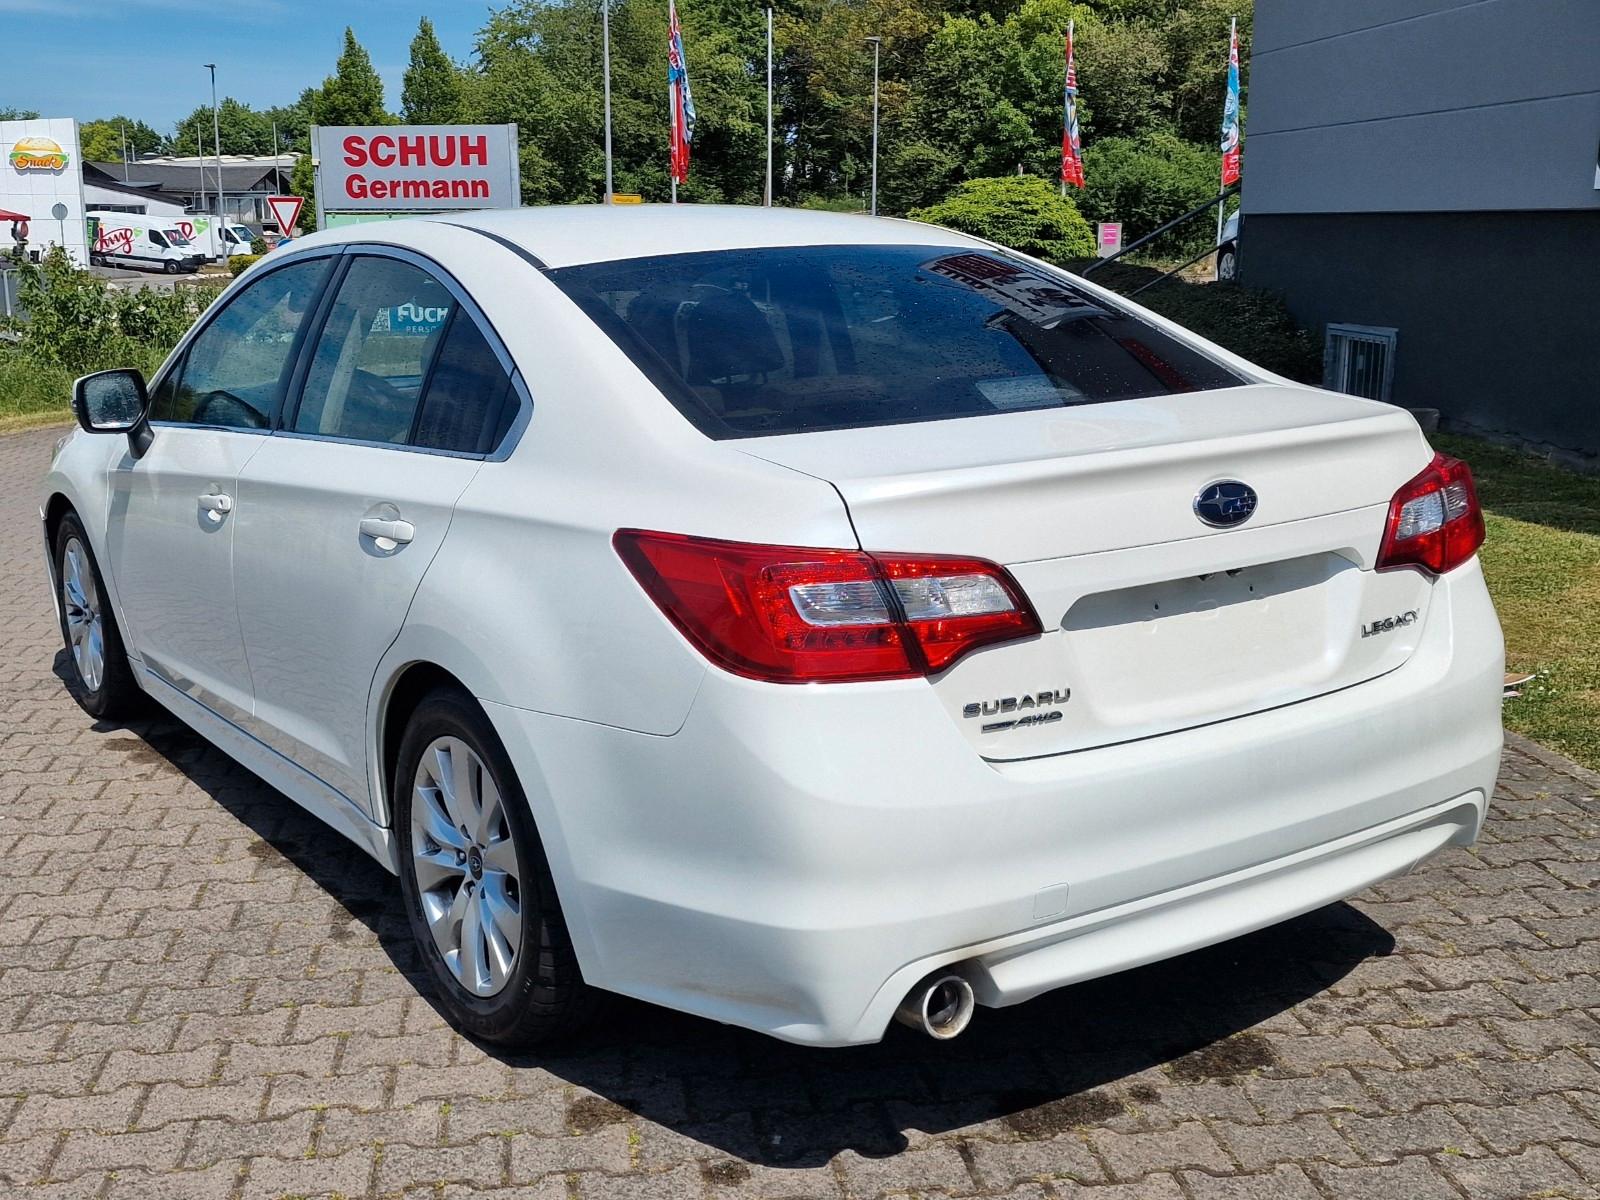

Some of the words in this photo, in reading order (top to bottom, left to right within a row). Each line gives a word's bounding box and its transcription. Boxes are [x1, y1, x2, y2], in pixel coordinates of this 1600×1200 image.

[15, 154, 64, 169] Snack
[342, 135, 488, 167] SCHUH
[345, 173, 489, 199] Germann
[1361, 608, 1420, 638] LEGACY
[963, 688, 1071, 718] SUBARU
[1013, 711, 1063, 729] AWD
